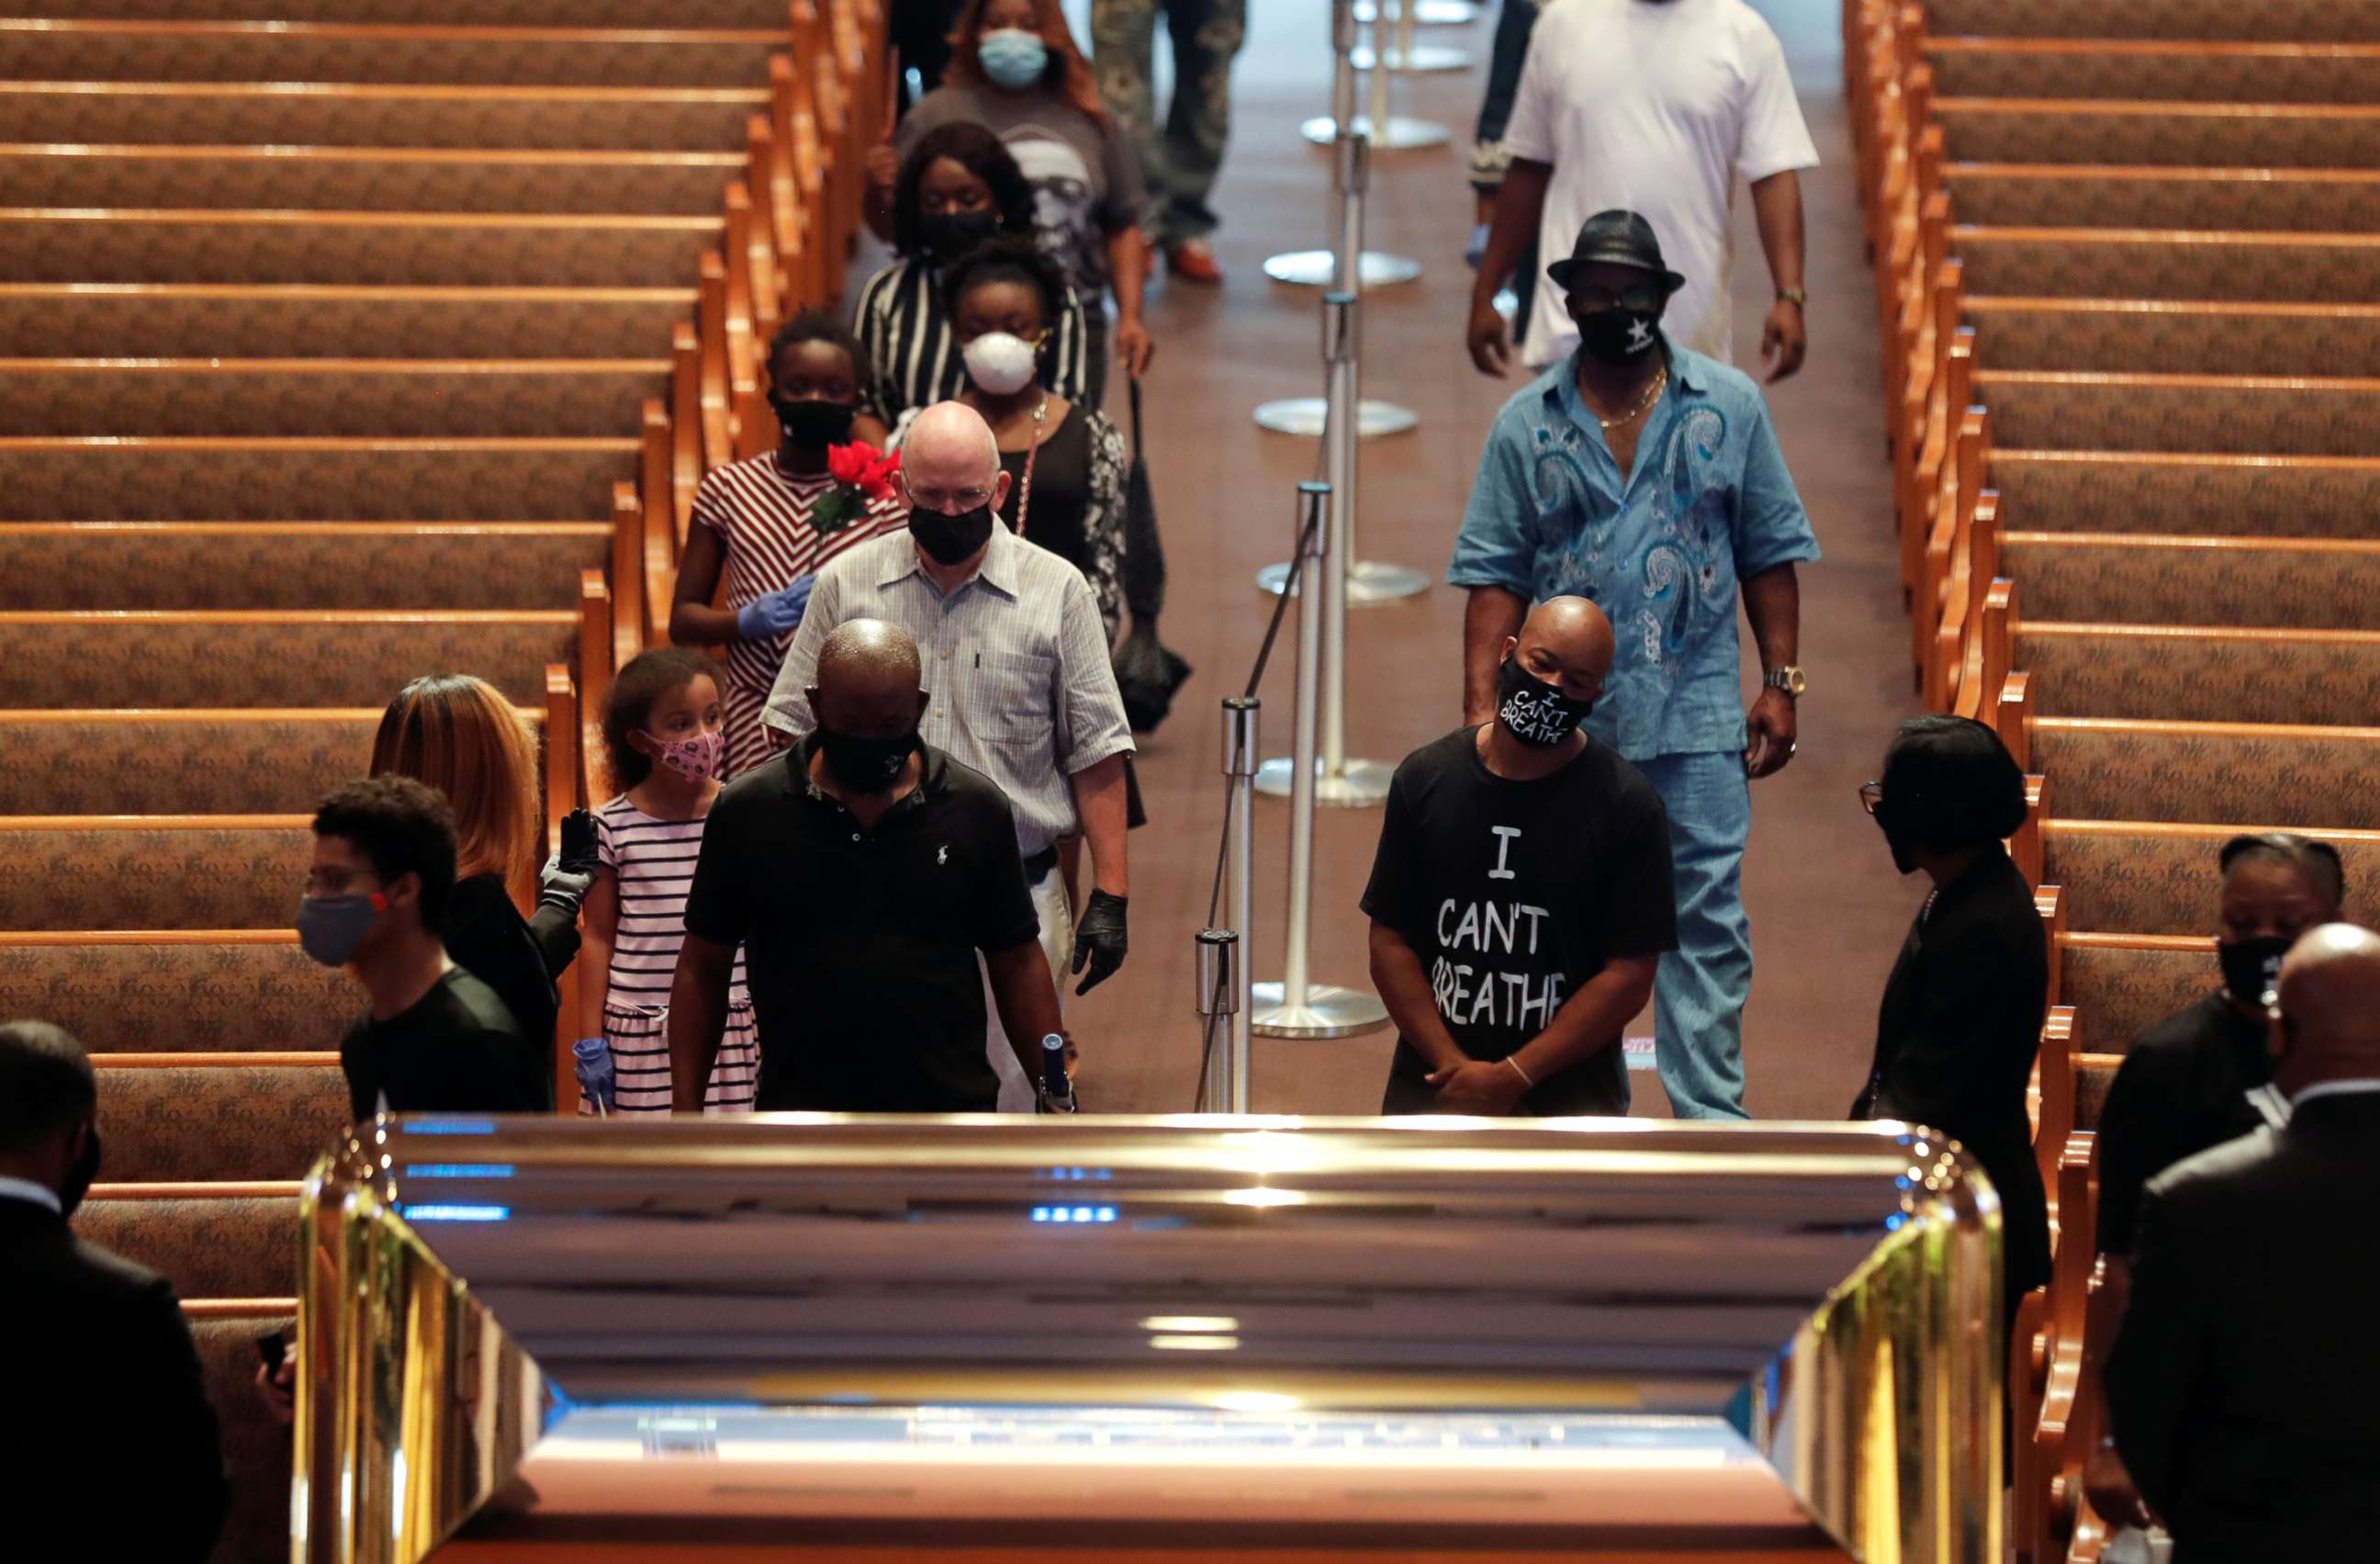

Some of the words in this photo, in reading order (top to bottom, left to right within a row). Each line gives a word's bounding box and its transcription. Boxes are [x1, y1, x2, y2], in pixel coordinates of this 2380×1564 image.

[1542, 691, 1560, 707] I
[1488, 826, 1521, 879] I
[1437, 898, 1549, 954] CAN'T
